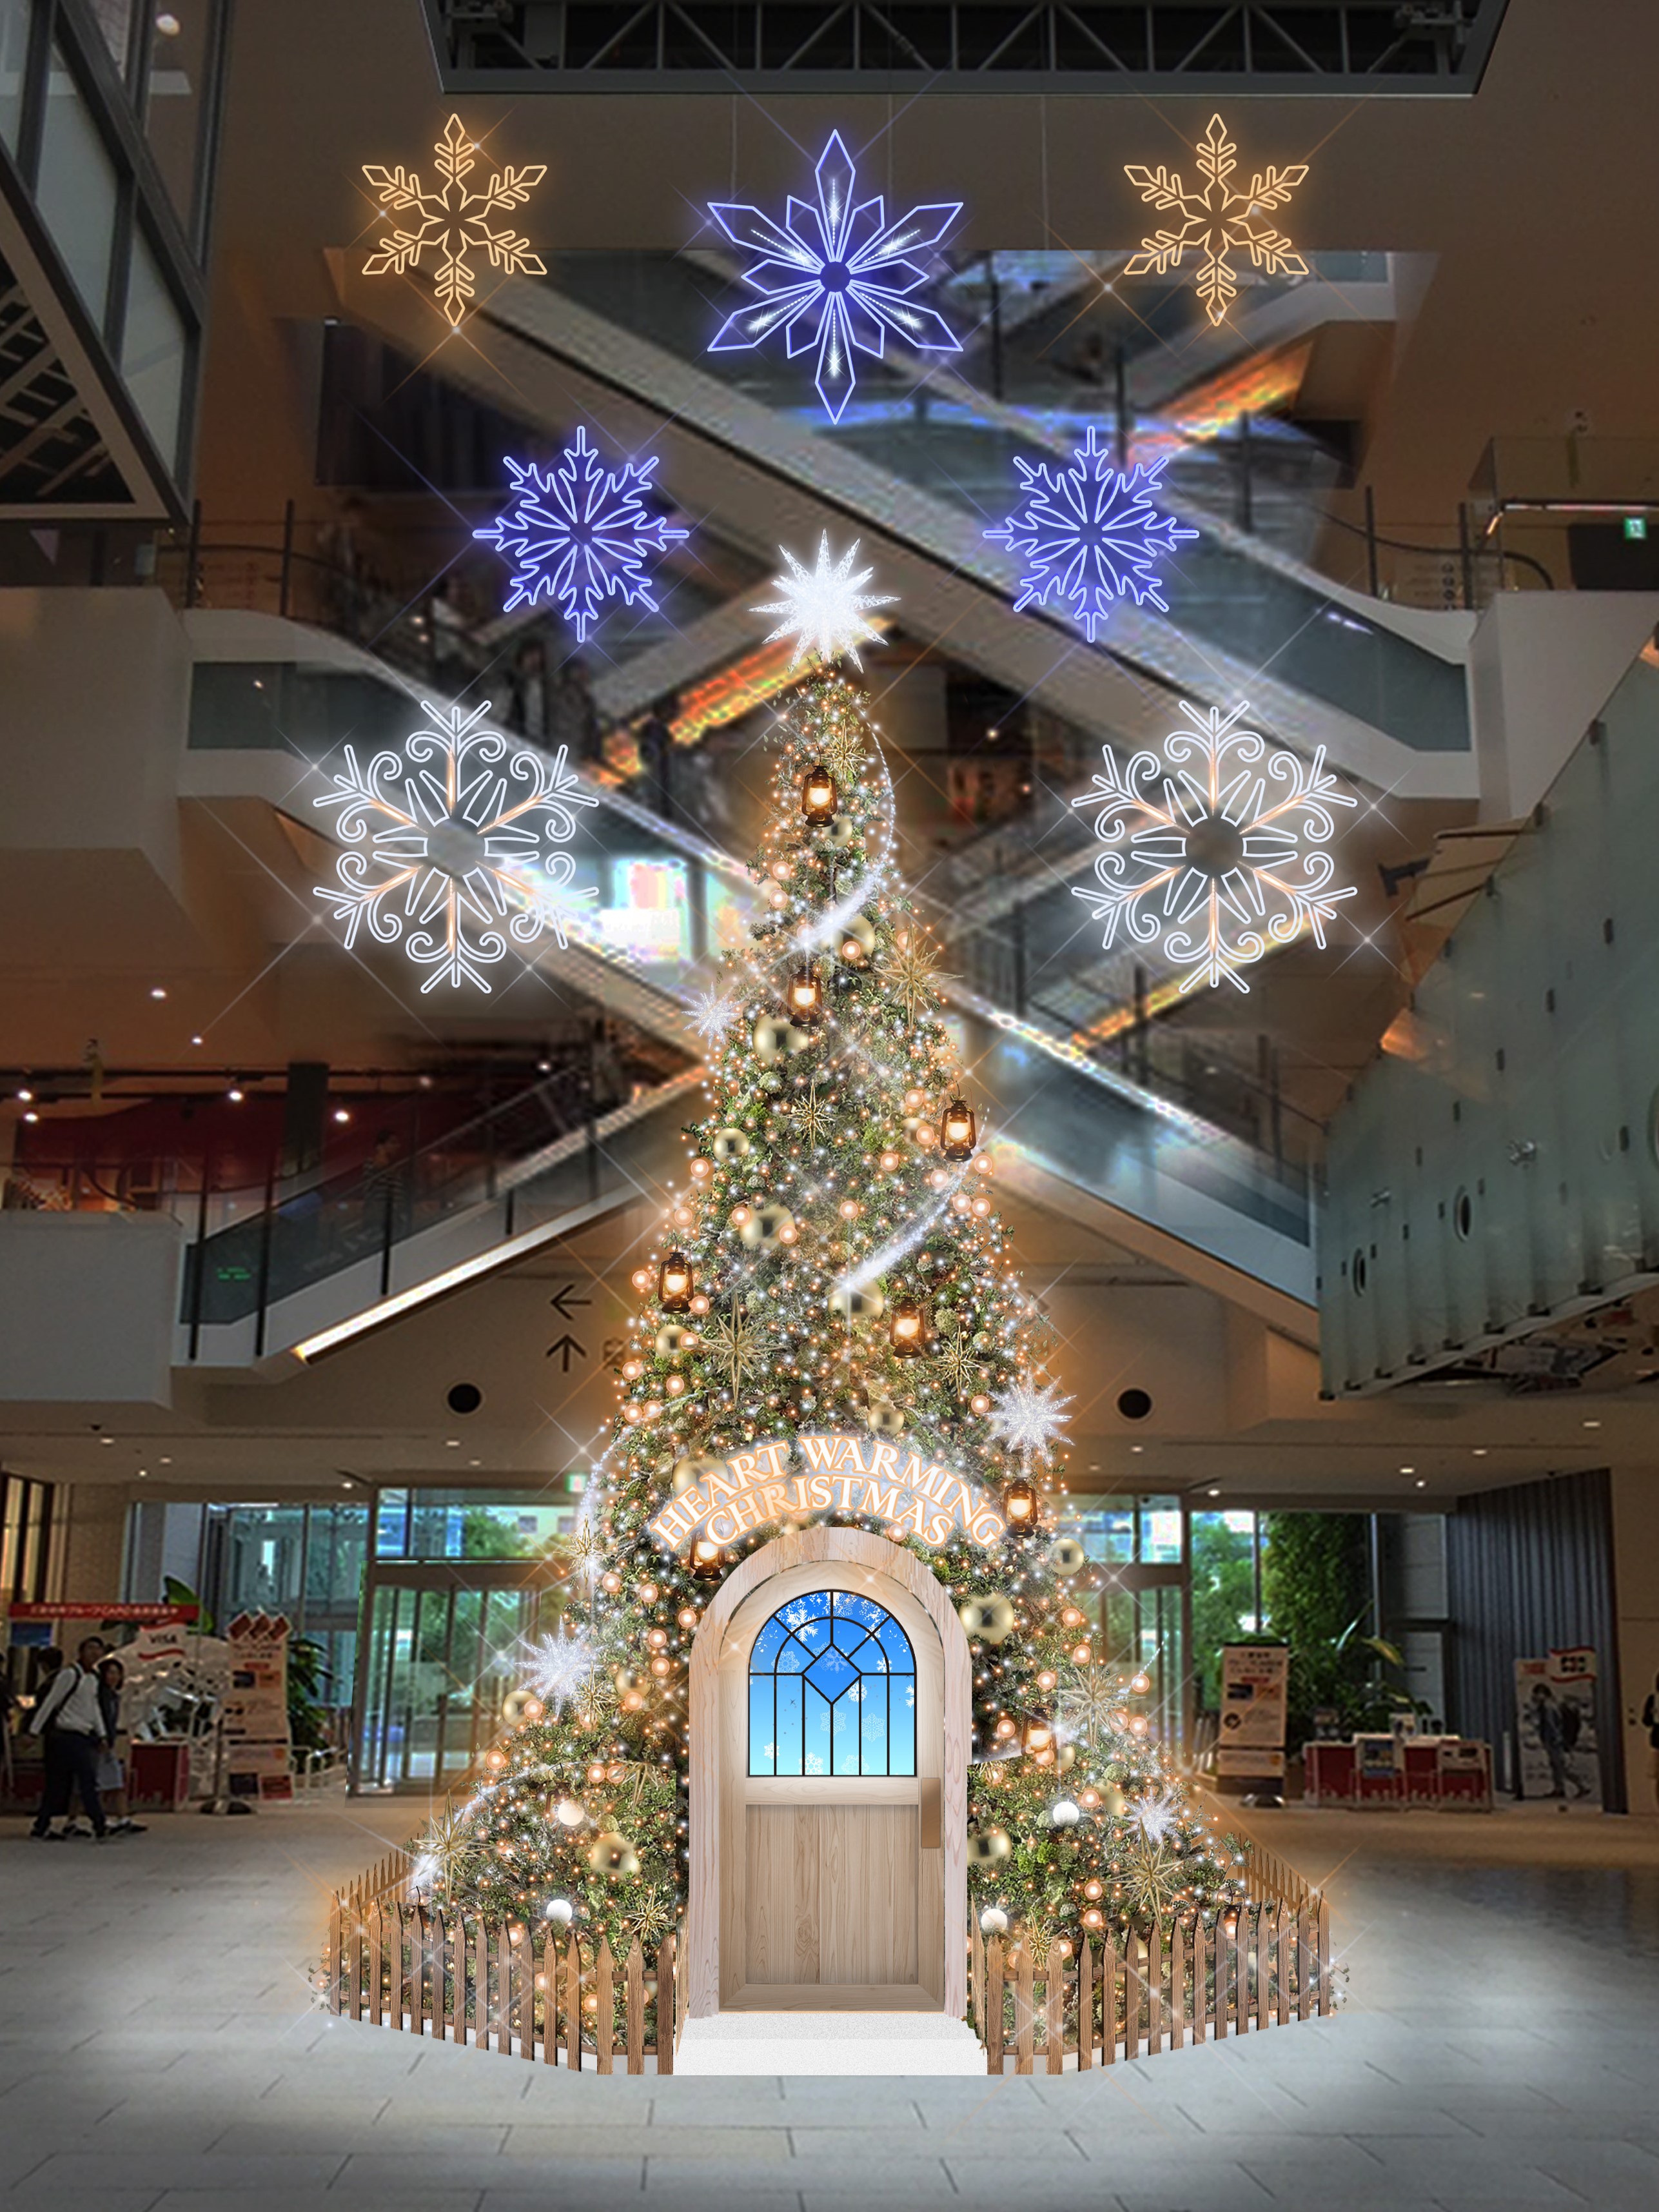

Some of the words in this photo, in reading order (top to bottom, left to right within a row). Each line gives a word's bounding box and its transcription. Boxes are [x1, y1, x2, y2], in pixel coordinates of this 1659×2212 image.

[649, 1439, 789, 1550] HEART
[798, 1435, 1007, 1548] WARMING
[704, 1474, 956, 1547] CHRISTMAS
